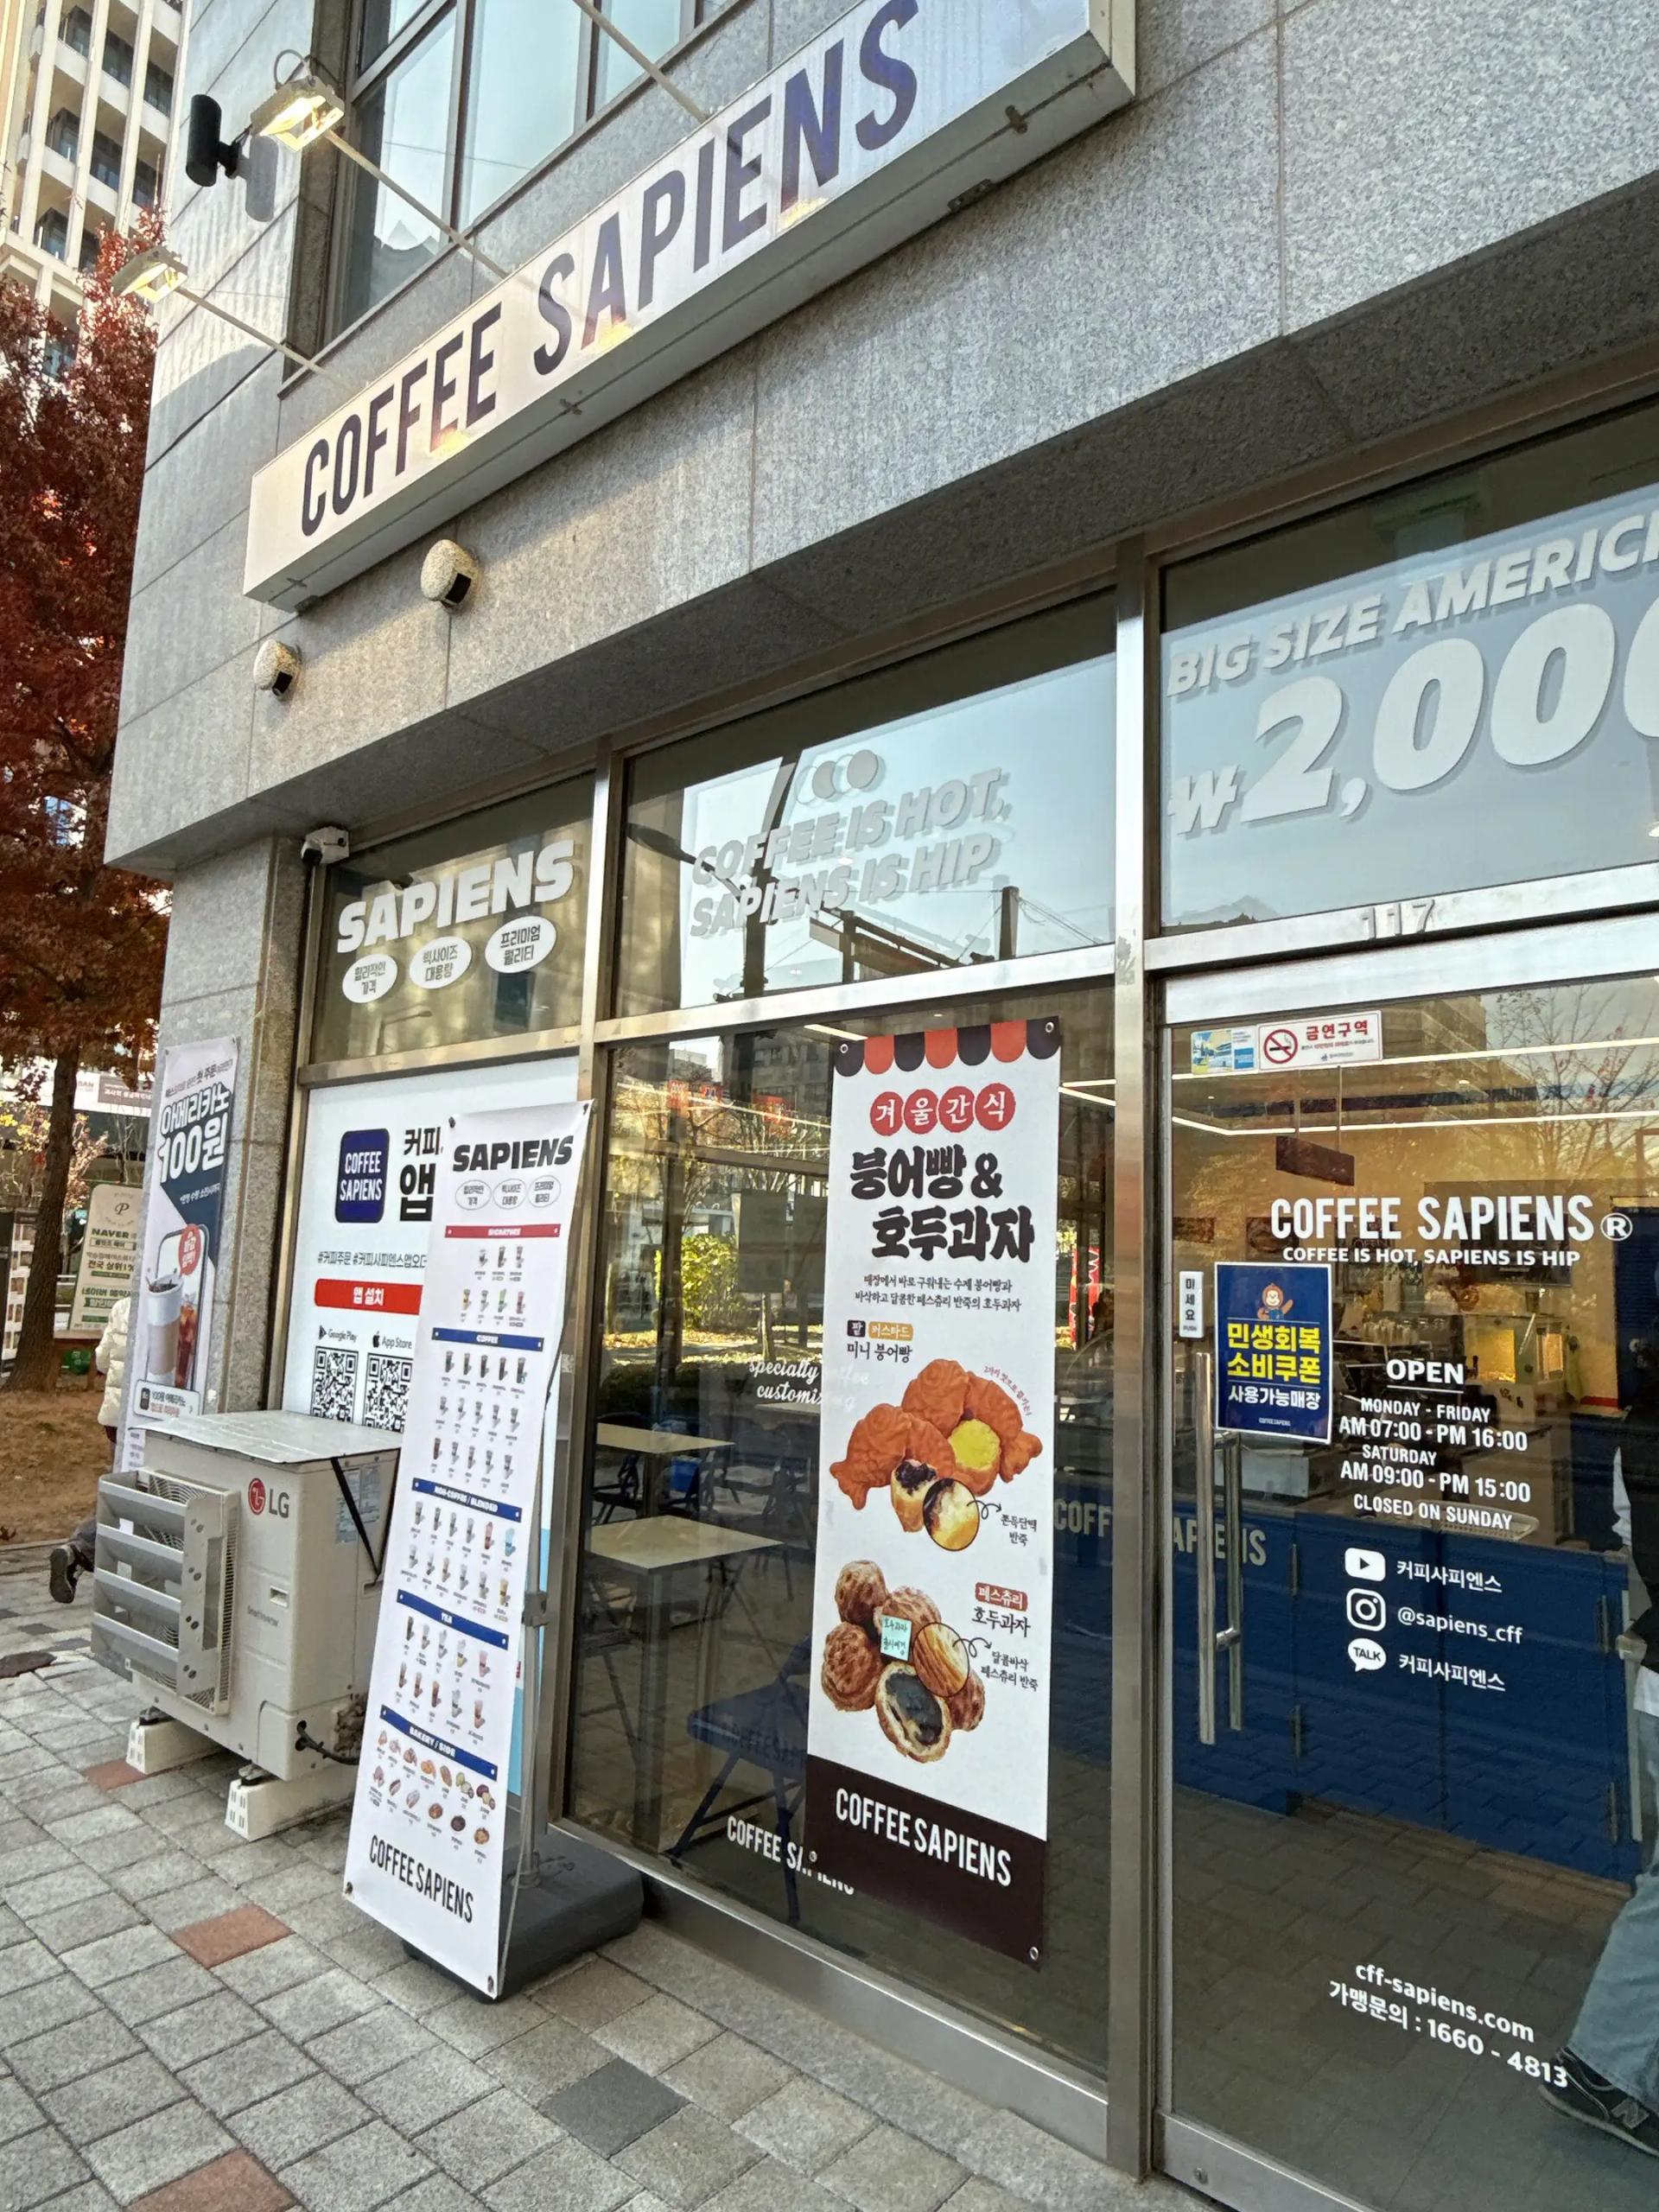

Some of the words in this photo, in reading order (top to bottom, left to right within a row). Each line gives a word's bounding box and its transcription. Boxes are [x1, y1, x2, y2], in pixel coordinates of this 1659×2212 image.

[302, 302, 502, 537] COFFEE
[533, 0, 919, 377] SAPIENS
[1166, 636, 1252, 696] BIG
[1262, 595, 1382, 668] SIZE
[1391, 508, 1659, 634] AMERIC
[693, 812, 839, 885] COFFEE
[845, 799, 887, 849] IS
[338, 840, 575, 953] SAPIENS
[691, 866, 852, 936] SAPIENS
[860, 854, 902, 903] IS
[910, 833, 994, 891] HIP
[1361, 899, 1435, 939] 117
[500, 925, 541, 948] 프리미엄
[423, 944, 458, 963] 빅사이즈
[504, 945, 534, 965] 퀄리티
[354, 962, 386, 981] 합리적인
[425, 963, 453, 982] 대용량
[361, 979, 376, 995] 가격
[1306, 1020, 1368, 1041] 금연구역
[160, 1082, 230, 1135] 아메리카노
[875, 1091, 1006, 1128] 겨울간식
[158, 1112, 228, 1184] 100원
[345, 1151, 381, 1175] COFFEE
[452, 1135, 574, 1172] SAPIENS
[340, 1179, 382, 1202] SAPIENS
[399, 1163, 435, 1222] 앱
[92, 1228, 129, 1238] NAVER
[1270, 1196, 1402, 1240] COFFEE
[872, 1205, 1035, 1262] 호두과자
[1283, 1246, 1349, 1262] COFFEE
[1354, 1248, 1370, 1262] IS
[1376, 1248, 1418, 1266] HOT,
[1424, 1249, 1510, 1266] SAPIENS
[1516, 1250, 1535, 1266] IS
[1542, 1250, 1580, 1267] HIP
[365, 1287, 385, 1306] 설치
[899, 1276, 916, 1288] 바로
[918, 1277, 951, 1290] 구워내는
[954, 1278, 972, 1291] 수제
[974, 1279, 1012, 1293] 붕어빵과
[855, 1291, 890, 1304] 바삭하고
[891, 1293, 914, 1306] 달콤한
[953, 1296, 980, 1310] 반죽의
[982, 1298, 1021, 1313] 호두과자
[382, 1336, 395, 1349] App
[395, 1337, 412, 1349] Store
[871, 1324, 911, 1338] 커스타드
[1227, 1323, 1320, 1354] 민생회복
[847, 1342, 870, 1360] 미니
[874, 1344, 912, 1363] 붕어빵
[749, 1358, 819, 1384] specialty
[1227, 1352, 1321, 1384] 소비쿠폰
[1387, 1359, 1465, 1384] OPEN
[1228, 1385, 1321, 1411] 사용가능매장
[1361, 1398, 1421, 1416] MONDAY
[1437, 1405, 1491, 1422] FRIDAY
[1339, 1416, 1368, 1436] AM
[1370, 1420, 1421, 1440] 07:00
[1437, 1426, 1466, 1446] PM
[1471, 1429, 1528, 1452] 16:00
[1362, 1446, 1437, 1465] SATURDAY
[1340, 1461, 1369, 1482] AM
[1372, 1466, 1423, 1489] 09:00
[1440, 1473, 1469, 1495] PM
[1476, 1478, 1531, 1503] 15:00
[269, 1488, 290, 1518] LG
[1053, 1498, 1113, 1537] COFF
[1354, 1494, 1413, 1516] CLOSED
[1419, 1502, 1440, 1520] ON
[1446, 1506, 1512, 1530] SUNDAY
[1009, 1531, 1028, 1547] 반죽
[1396, 1560, 1503, 1593] 커피사피엔스
[978, 1586, 1023, 1610] 페스츄리
[972, 1605, 1031, 1637] 호두과자
[1397, 1606, 1523, 1644] @sapiens_cff
[992, 1651, 1028, 1672] 달콤바삭
[1352, 1646, 1382, 1662] TALK
[981, 1665, 1016, 1686] 페스츄리
[1020, 1675, 1038, 1692] 반죽
[1398, 1654, 1506, 1692] 커피사피엔스
[728, 1815, 781, 1862] COFFEE
[836, 1788, 910, 1847] COFFEE
[914, 1818, 1012, 1887] SAPIENS
[369, 1834, 415, 1888] COFFEE
[416, 1862, 474, 1923] SAPIENS
[1356, 1964, 1534, 2043] cff-sapiens.com
[1427, 2018, 1484, 2056] 1660
[1507, 2051, 1567, 2088] 4813
